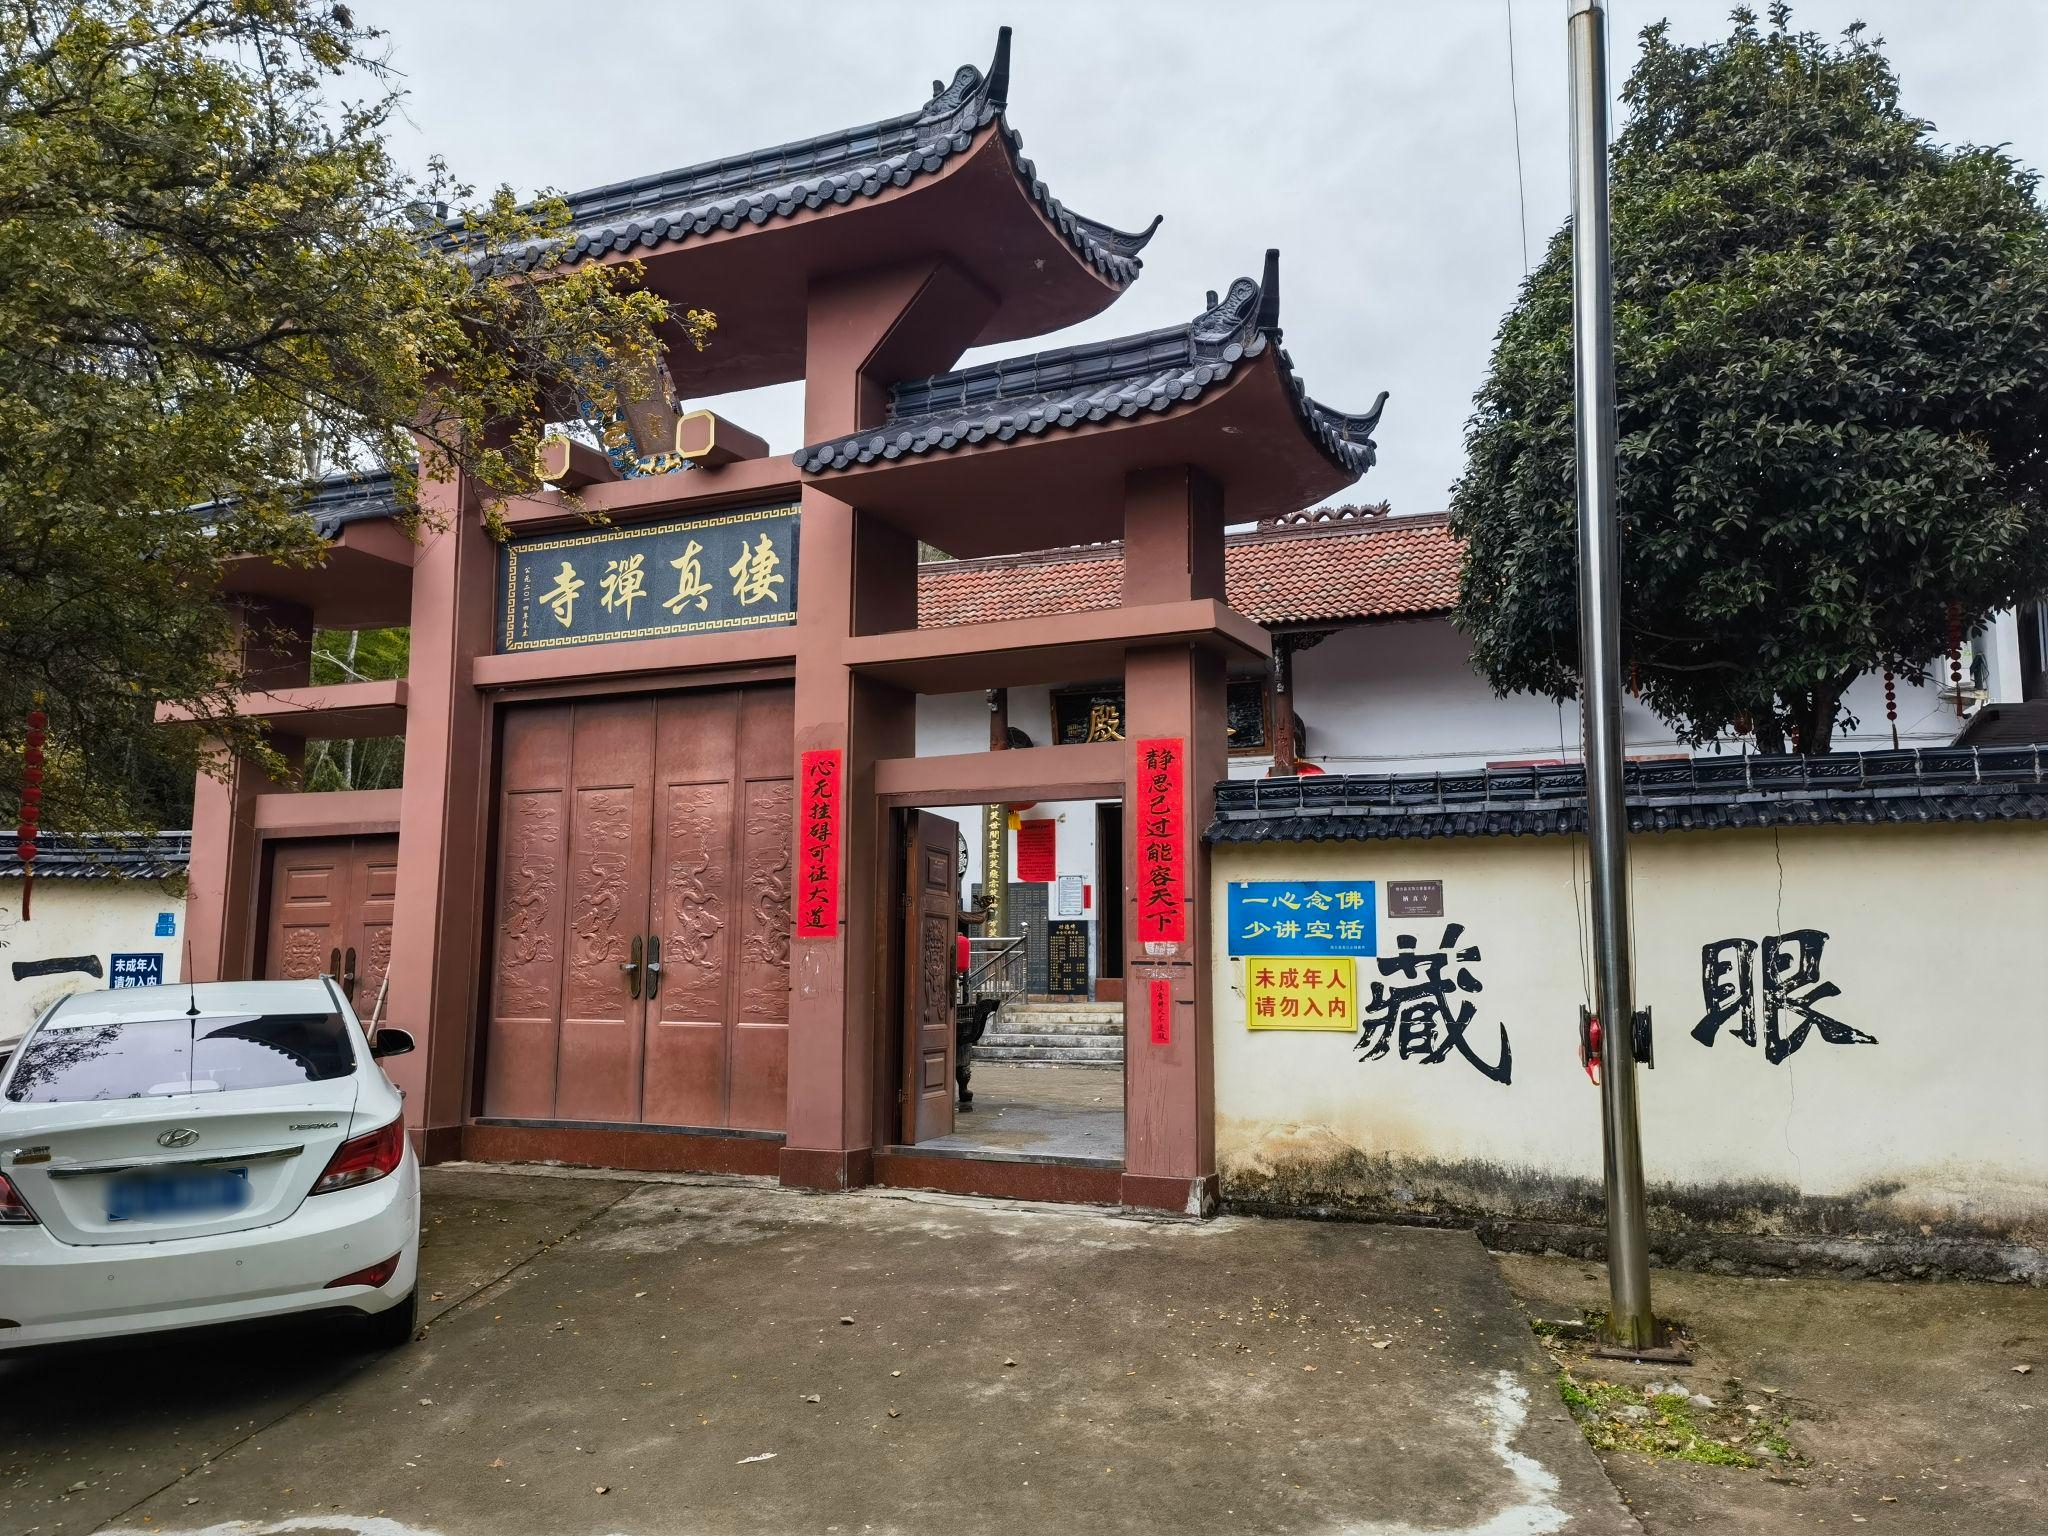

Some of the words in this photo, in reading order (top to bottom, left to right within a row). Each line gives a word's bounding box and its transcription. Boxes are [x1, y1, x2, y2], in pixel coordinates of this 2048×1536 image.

[1144, 748, 1179, 932] 静思己过能容天下
[1242, 890, 1364, 910] 一心念佛
[1241, 919, 1364, 940] 少讲空话
[115, 958, 158, 972] 未成年人
[1255, 968, 1347, 989] 未成年人
[1255, 996, 1347, 1018] 请勿入内
[1353, 923, 1512, 1086] 藏
[1690, 928, 1880, 1066] 眼
